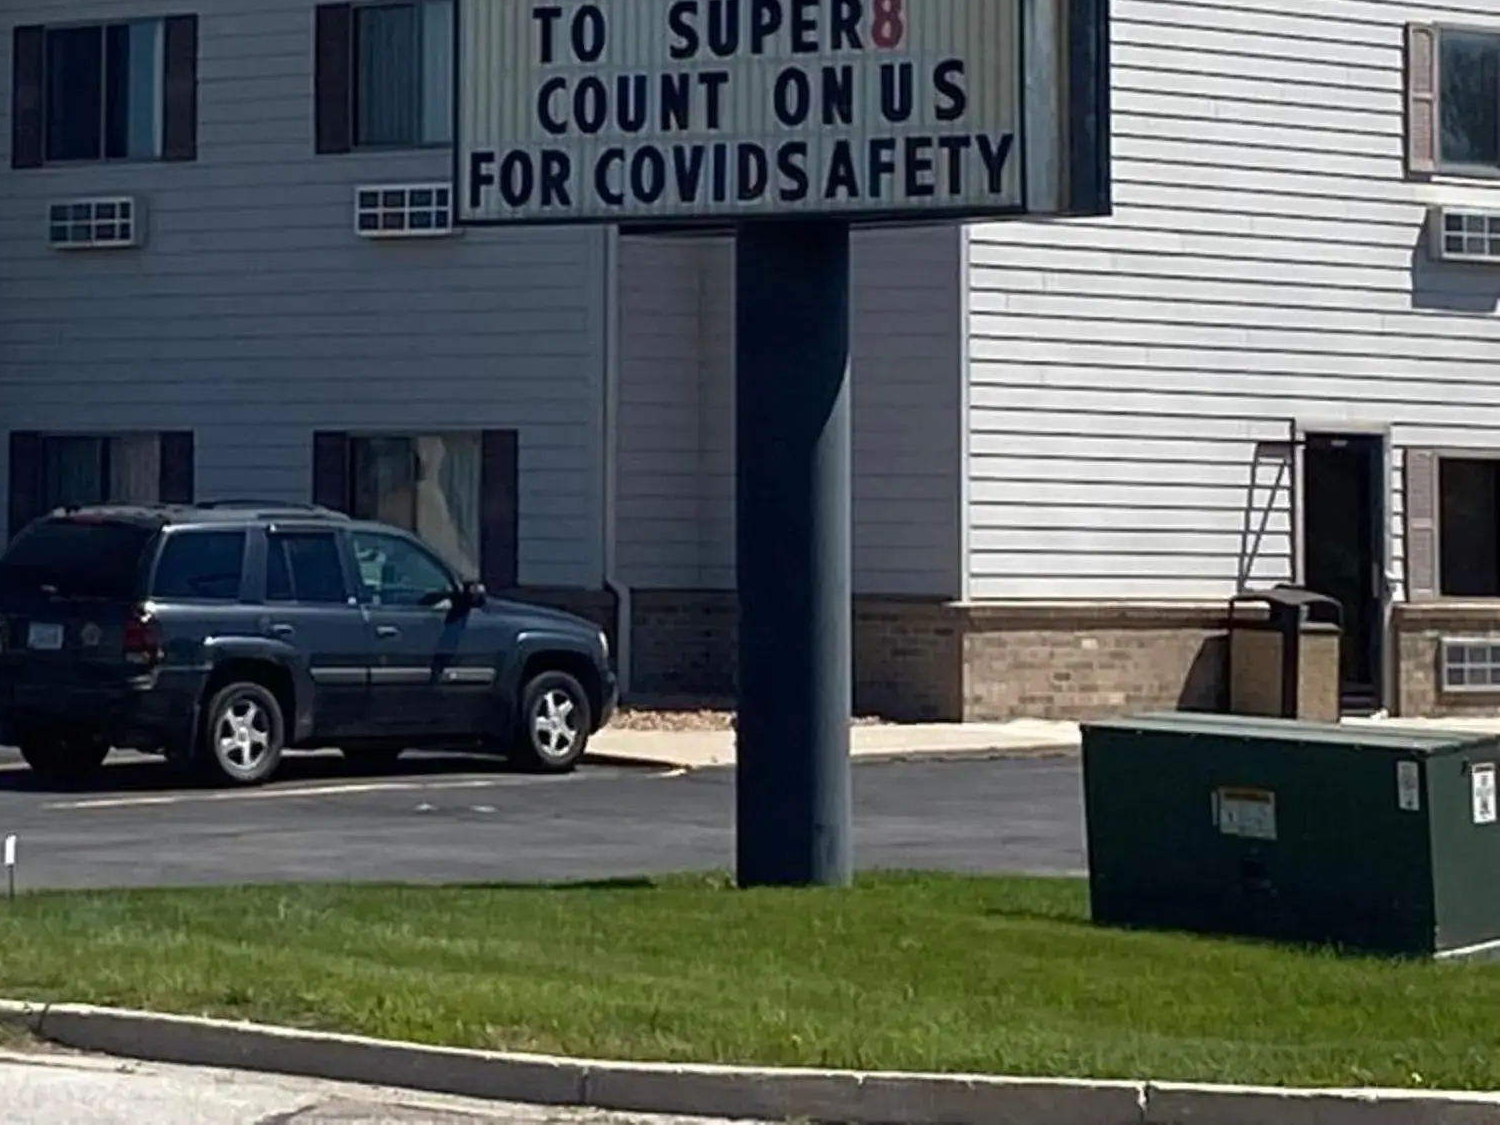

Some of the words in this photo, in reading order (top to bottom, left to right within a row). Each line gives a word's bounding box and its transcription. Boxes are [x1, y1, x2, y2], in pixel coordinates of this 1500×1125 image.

[532, 4, 606, 65] TO
[537, 70, 730, 135] COUNT
[469, 149, 572, 209] FOR
